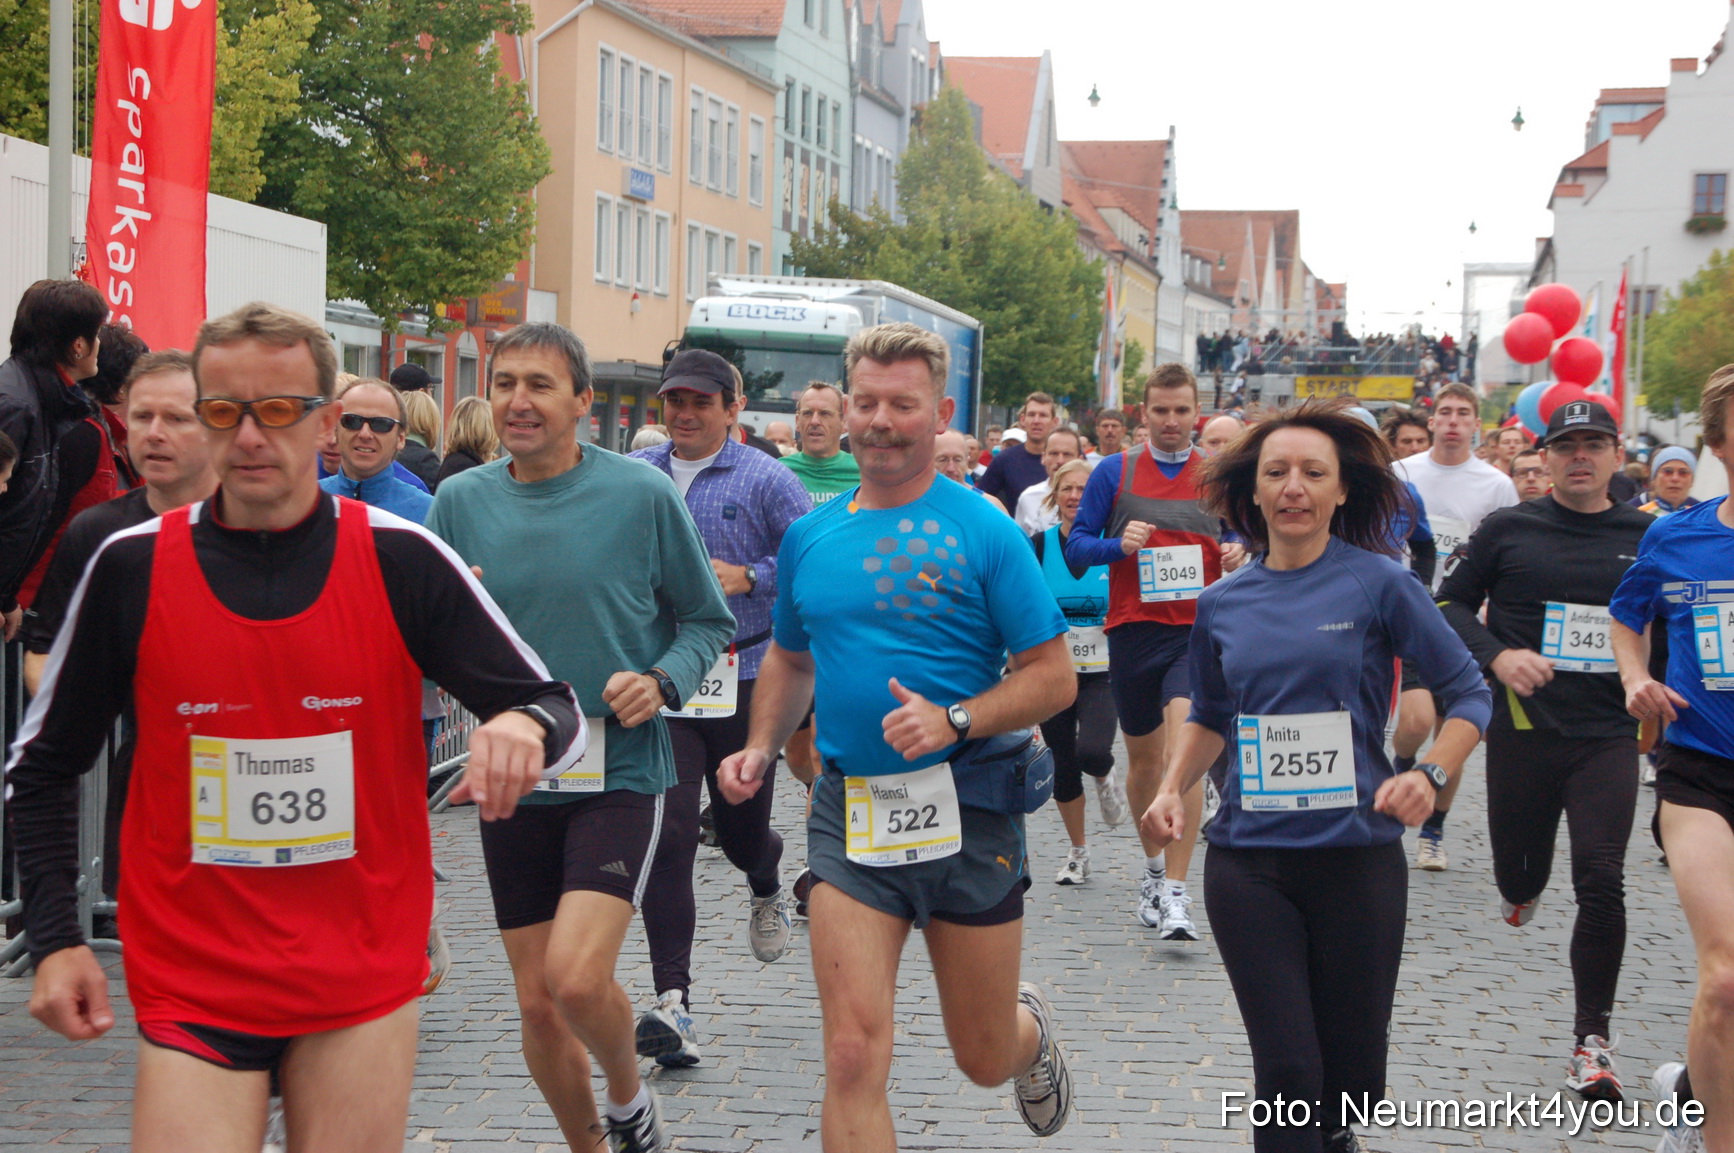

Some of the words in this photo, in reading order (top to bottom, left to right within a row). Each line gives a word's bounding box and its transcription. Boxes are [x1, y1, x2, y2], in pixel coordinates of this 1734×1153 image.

[727, 303, 807, 321] BOCK
[1306, 379, 1360, 393] START
[1157, 552, 1173, 562] Falk
[1160, 566, 1196, 581] 3049
[1073, 644, 1096, 656] 691
[1705, 638, 1711, 649] A
[698, 679, 723, 696] 62
[1266, 726, 1300, 742] Anita
[235, 752, 315, 775] Thomas
[1245, 751, 1252, 764] B
[1270, 750, 1338, 777] 2557
[198, 786, 208, 803] A
[871, 783, 908, 800] Hansi
[1310, 793, 1354, 803] PFLEIDERER
[252, 788, 326, 825] 638
[851, 811, 858, 824] A
[887, 804, 939, 834] 522
[294, 840, 351, 855] PFLEIDERER
[919, 841, 959, 855] PFLEIDERER
